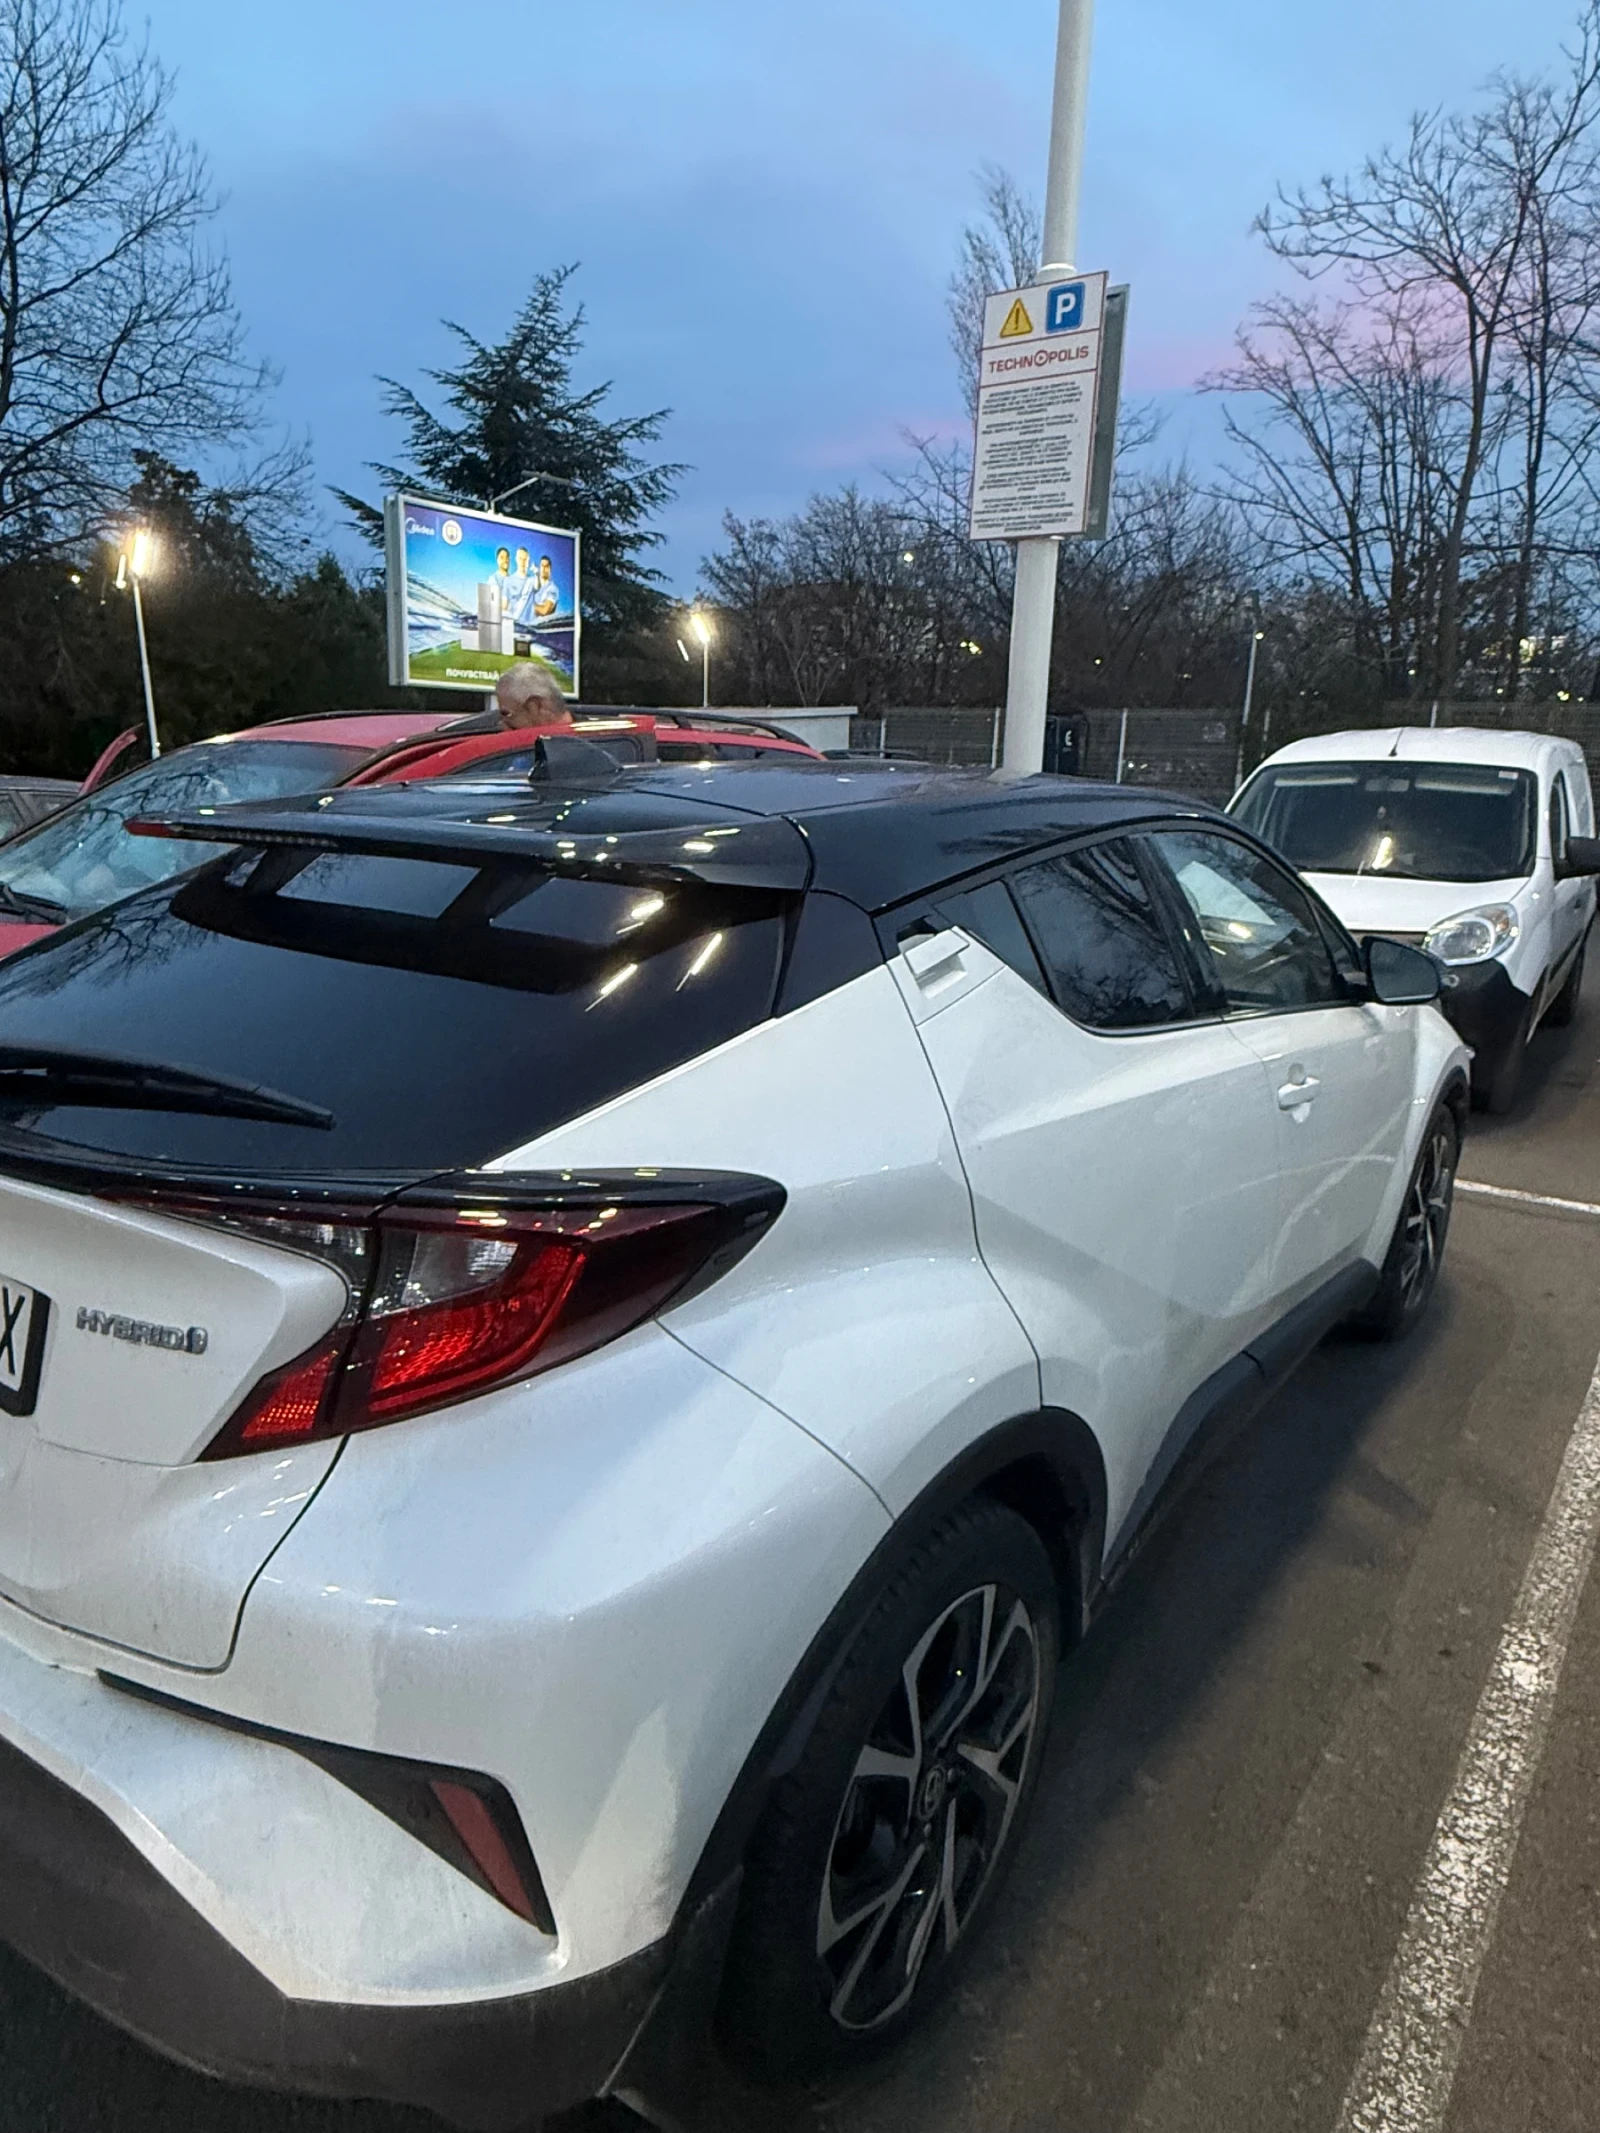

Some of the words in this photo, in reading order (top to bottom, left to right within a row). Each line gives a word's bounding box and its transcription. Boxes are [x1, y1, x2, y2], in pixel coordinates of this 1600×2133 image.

[1055, 292, 1076, 325] P
[988, 345, 1089, 373] TECHNOPOLIS
[76, 1306, 185, 1351] HYBRID
